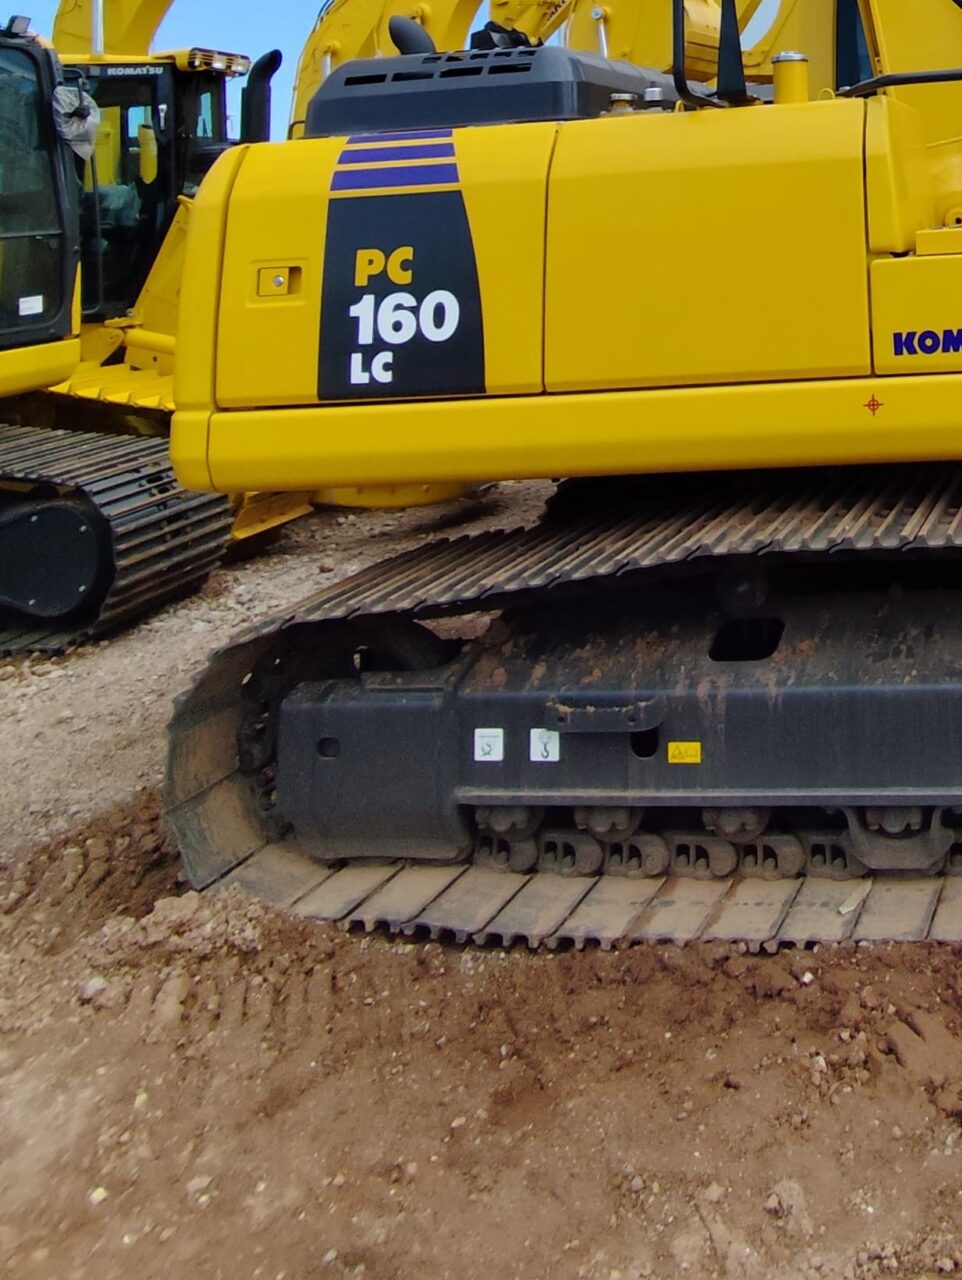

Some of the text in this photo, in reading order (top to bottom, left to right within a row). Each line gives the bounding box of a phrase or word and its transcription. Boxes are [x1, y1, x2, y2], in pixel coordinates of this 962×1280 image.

[107, 65, 164, 76] KOMATSU
[354, 246, 414, 287] PC
[349, 289, 460, 345] 160
[350, 351, 393, 384] LC
